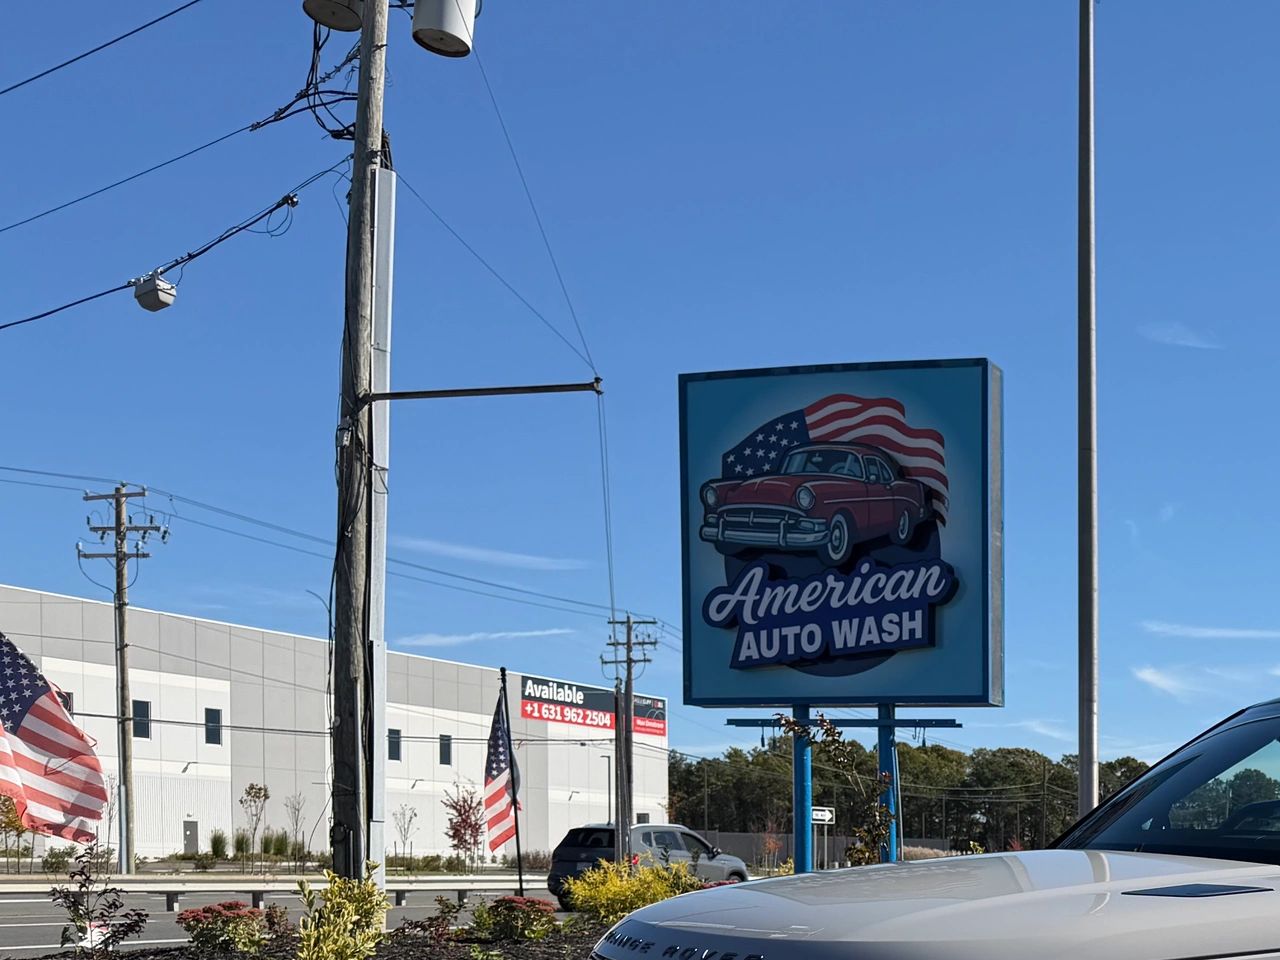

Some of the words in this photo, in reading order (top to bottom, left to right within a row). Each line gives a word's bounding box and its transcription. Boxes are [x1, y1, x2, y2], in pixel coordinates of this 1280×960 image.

[709, 563, 947, 625] American
[738, 623, 822, 661] AUTO
[832, 609, 923, 649] WASH
[525, 680, 584, 704] Available
[525, 703, 539, 717] +1
[541, 704, 562, 720] 631
[564, 708, 584, 724] 962
[585, 711, 611, 727] 2504
[604, 931, 656, 953] RANGE
